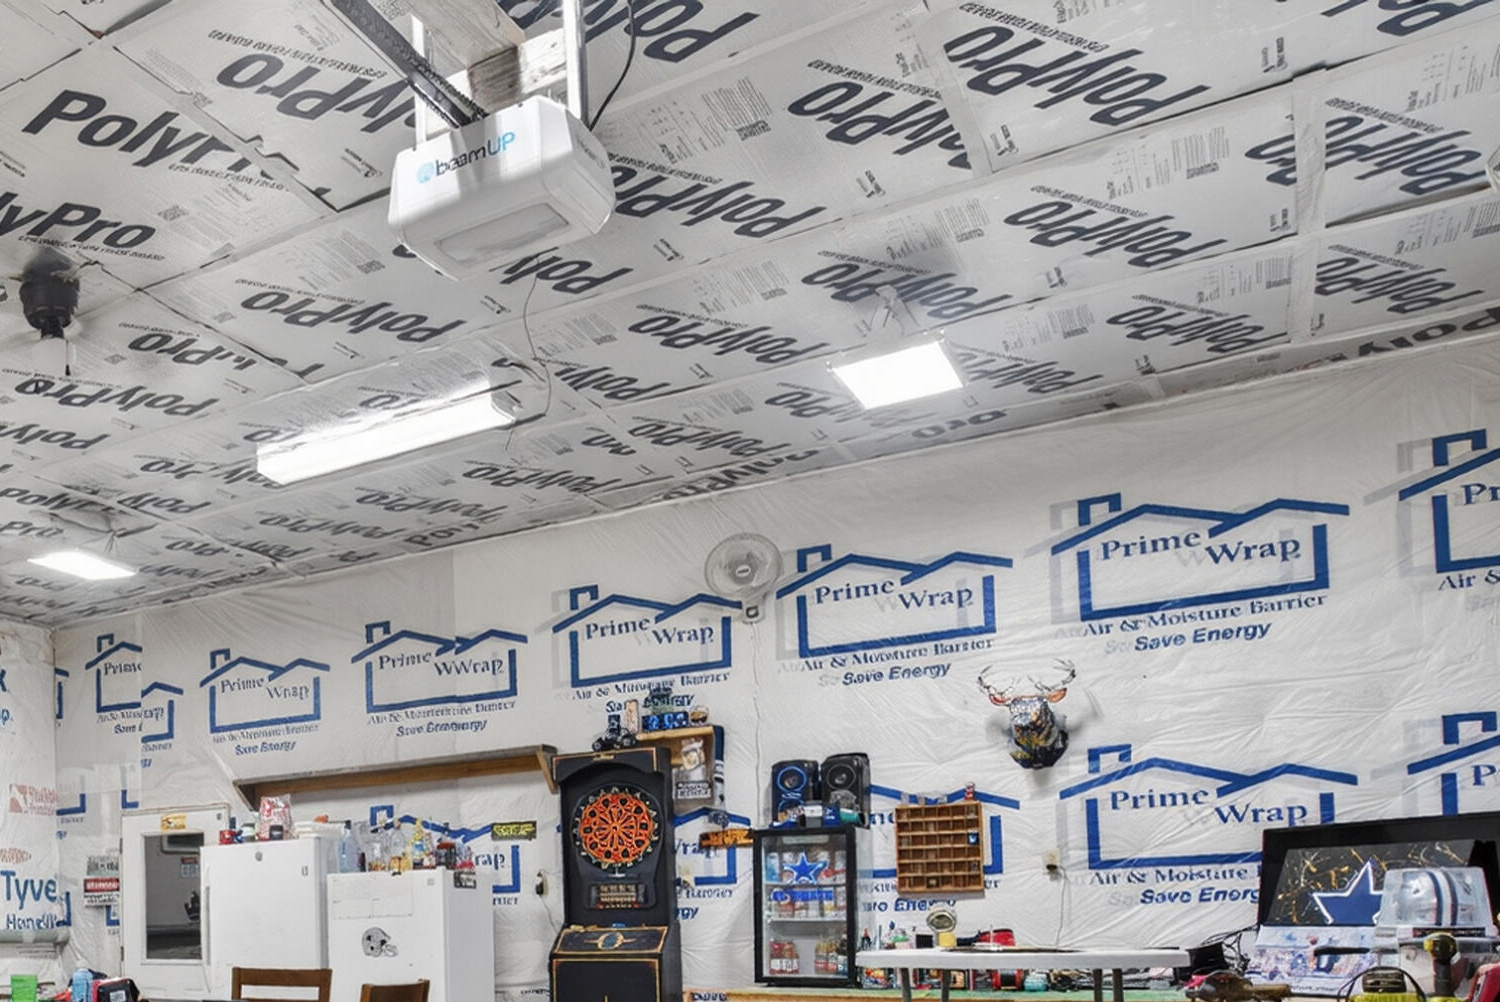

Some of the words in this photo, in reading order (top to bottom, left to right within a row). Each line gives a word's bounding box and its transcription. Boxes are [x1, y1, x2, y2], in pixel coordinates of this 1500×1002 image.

[943, 25, 1212, 127] PolyPro
[1003, 201, 1228, 268] PolyPro
[241, 291, 467, 342] PolyPro
[1105, 304, 1289, 353] PolyPro
[628, 315, 831, 364] PolyPro
[15, 377, 220, 417] PolyPro
[1101, 529, 1201, 561] Prime
[1205, 538, 1301, 565] Wrap
[815, 580, 895, 605] Prime
[1438, 572, 1477, 591] Air
[898, 586, 974, 609] Wrap
[585, 616, 651, 640] Prime
[1084, 621, 1113, 637] Air
[1146, 607, 1241, 629] Moisture
[1249, 594, 1328, 615] Barrier
[651, 624, 715, 646] Wrap
[1134, 631, 1186, 652] Save
[1192, 621, 1271, 645] Energy
[378, 650, 433, 671] Prime
[842, 669, 884, 686] Save
[888, 662, 951, 681] Energy
[1110, 789, 1210, 811] Prime
[1215, 804, 1309, 828] Wrap
[1090, 870, 1123, 886] Air
[1155, 865, 1249, 883] Moisture
[0, 869, 58, 910] Tyve
[1140, 887, 1192, 905] Save
[1197, 886, 1259, 906] Energ
